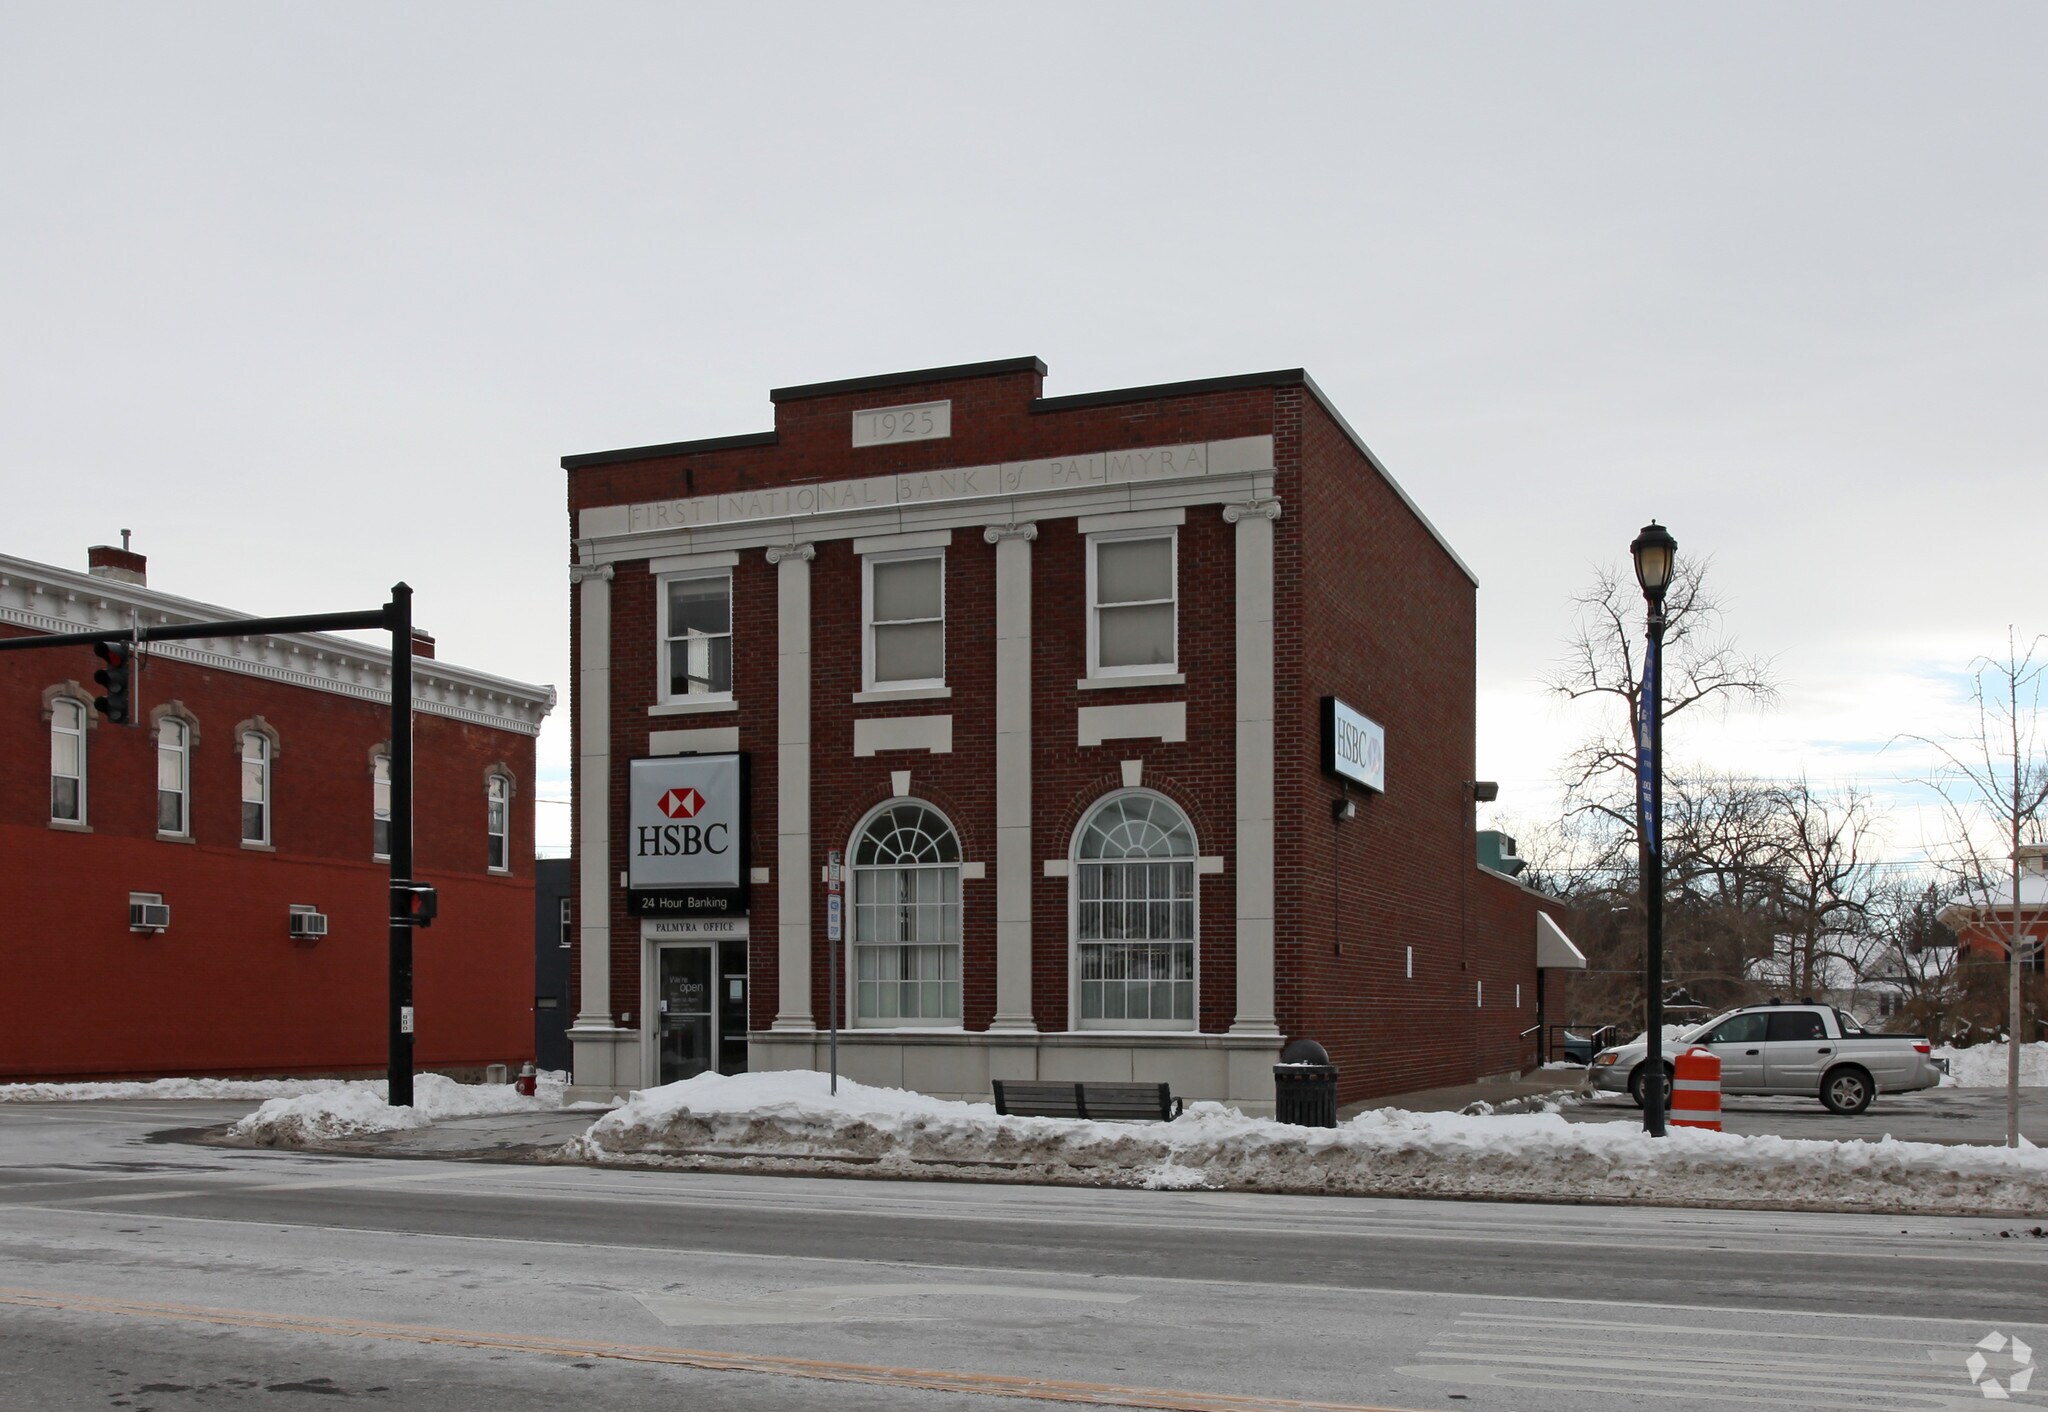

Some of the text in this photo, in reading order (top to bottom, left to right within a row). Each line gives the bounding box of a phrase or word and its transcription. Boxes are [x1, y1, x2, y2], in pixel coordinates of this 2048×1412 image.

[872, 411, 934, 438] 1925
[631, 448, 1203, 528] FIRST NATIONAL BANK of PALMYRA
[1337, 716, 1367, 768] HSBC
[637, 823, 729, 856] HSBC
[642, 896, 727, 910] 24 Hour Banking
[656, 922, 735, 932] PALMYRA OFFICE
[680, 983, 704, 994] open
